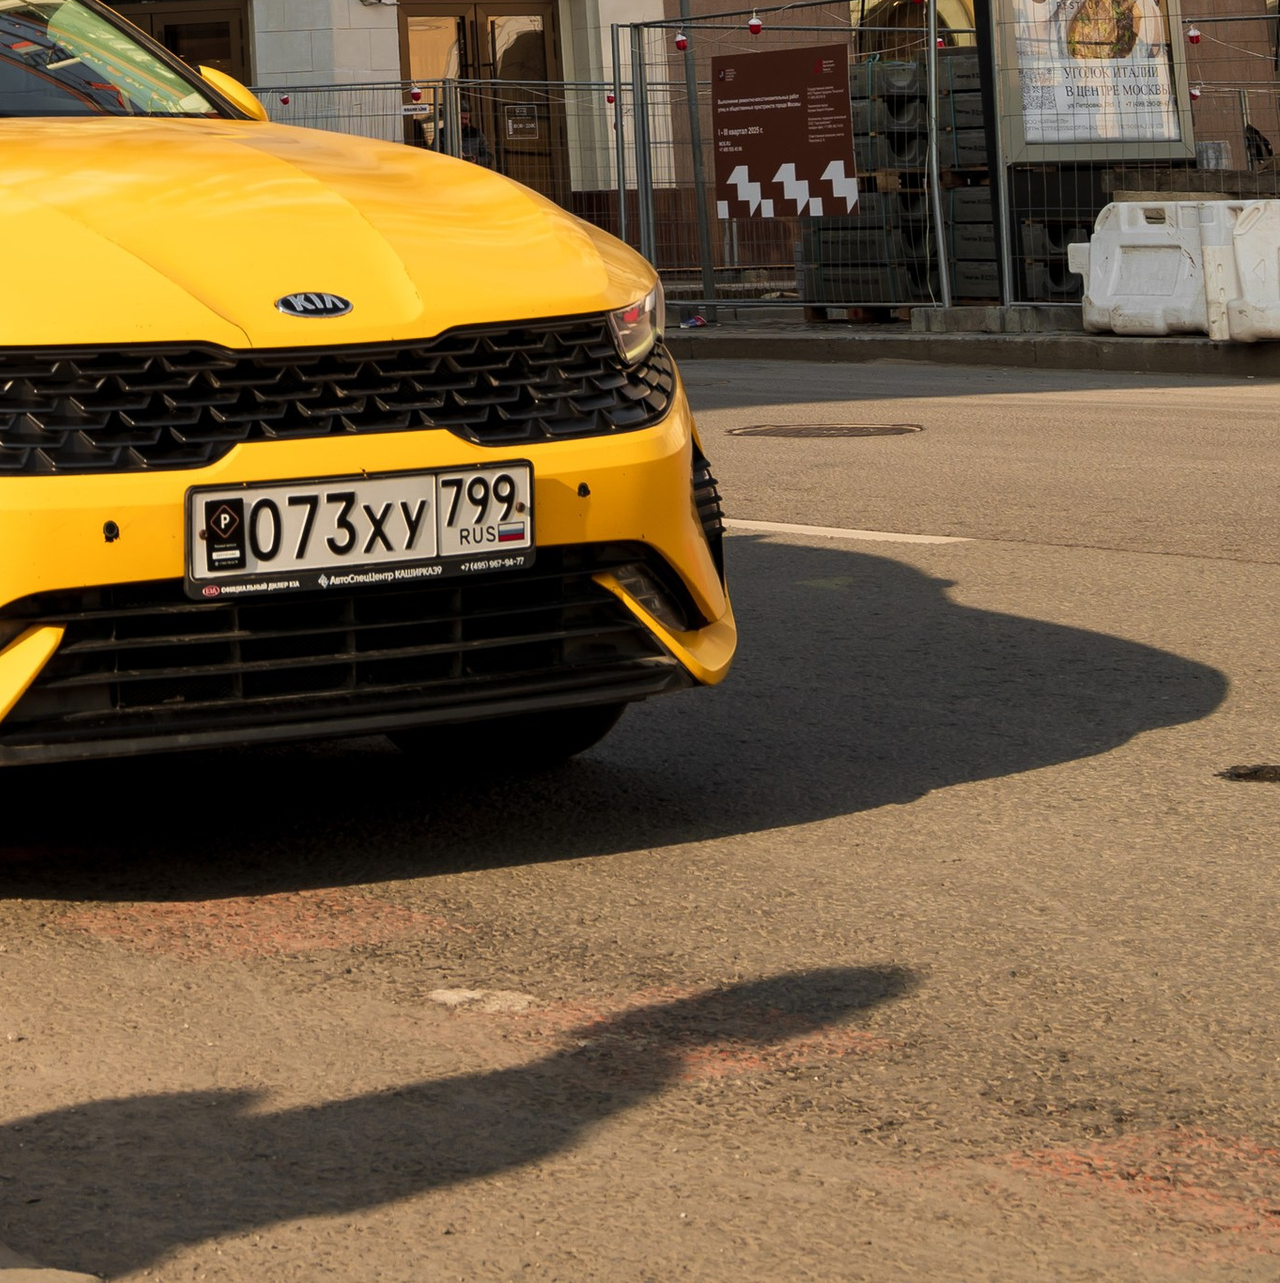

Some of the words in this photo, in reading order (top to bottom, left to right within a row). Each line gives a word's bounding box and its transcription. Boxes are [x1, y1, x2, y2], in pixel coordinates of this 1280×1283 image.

[1064, 66, 1110, 80] УГОЛОК
[1113, 66, 1159, 79] ИТАЛИИ
[1066, 86, 1074, 97] В
[1077, 85, 1120, 99] ЦЕНТРЕ
[1123, 83, 1170, 96] МОСКВЫ
[287, 293, 345, 312] KIA
[440, 473, 516, 528] 799
[460, 526, 497, 546] RUS
[330, 572, 394, 586] АвтоСпецЦентр
[394, 565, 443, 579] КАШИРКА39
[461, 563, 470, 571] +7
[470, 560, 489, 572] (495)
